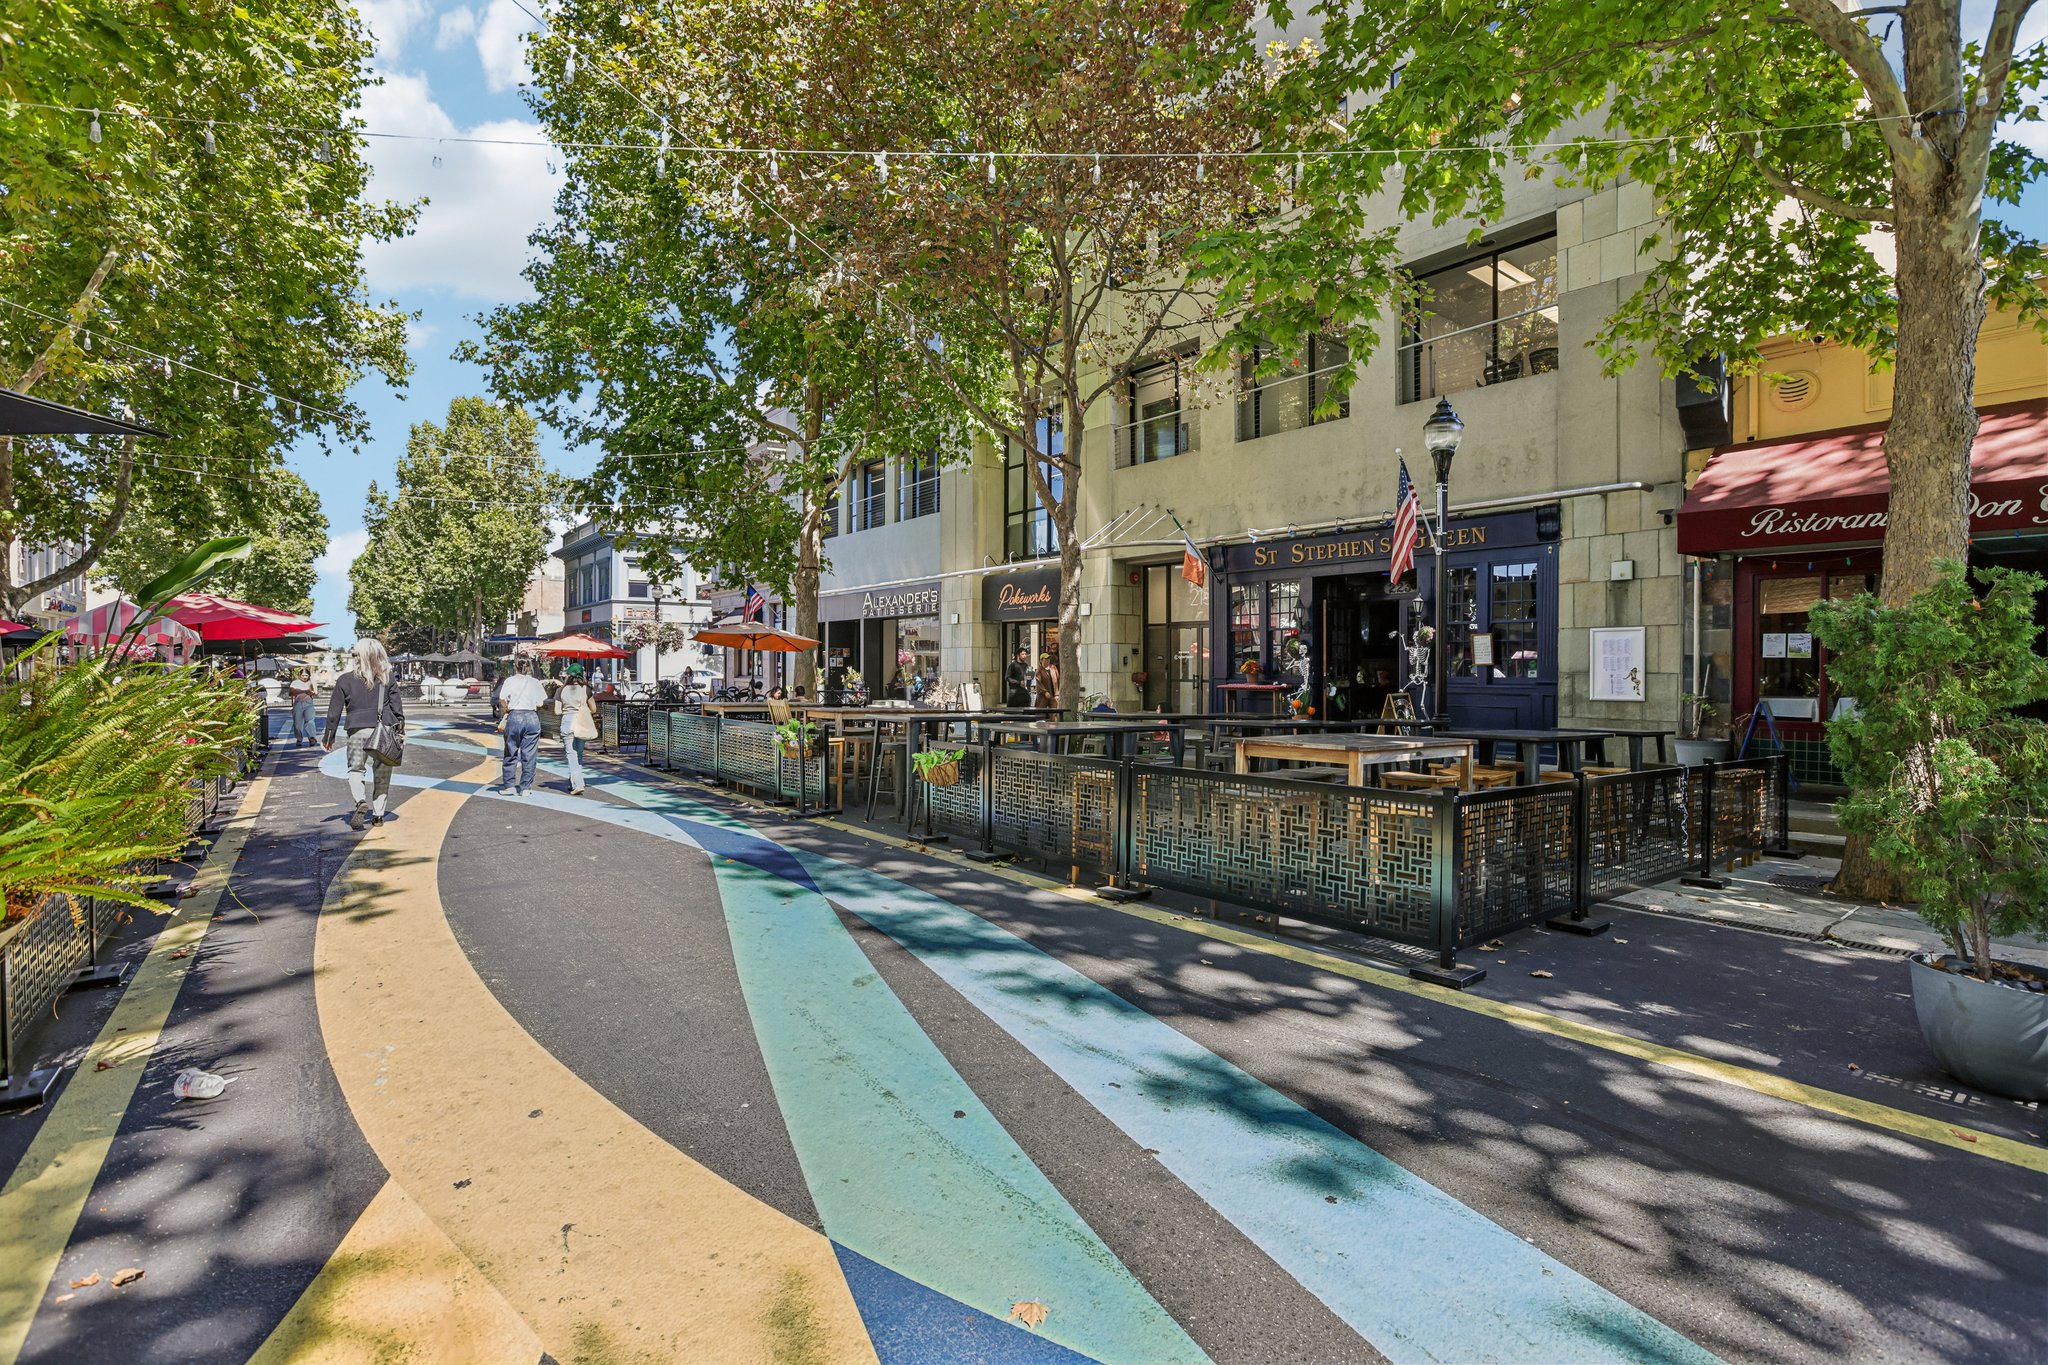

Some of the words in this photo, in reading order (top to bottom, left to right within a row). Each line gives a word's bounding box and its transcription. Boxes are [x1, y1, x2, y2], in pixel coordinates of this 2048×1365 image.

[1741, 507, 1889, 537] Ristorant
[1254, 546, 1278, 566] ST
[1291, 532, 1392, 564] STEPHEN'S
[1413, 526, 1487, 549] GEEN
[862, 588, 938, 610] ALEXANDER'S
[862, 603, 938, 617] PATISSERIE
